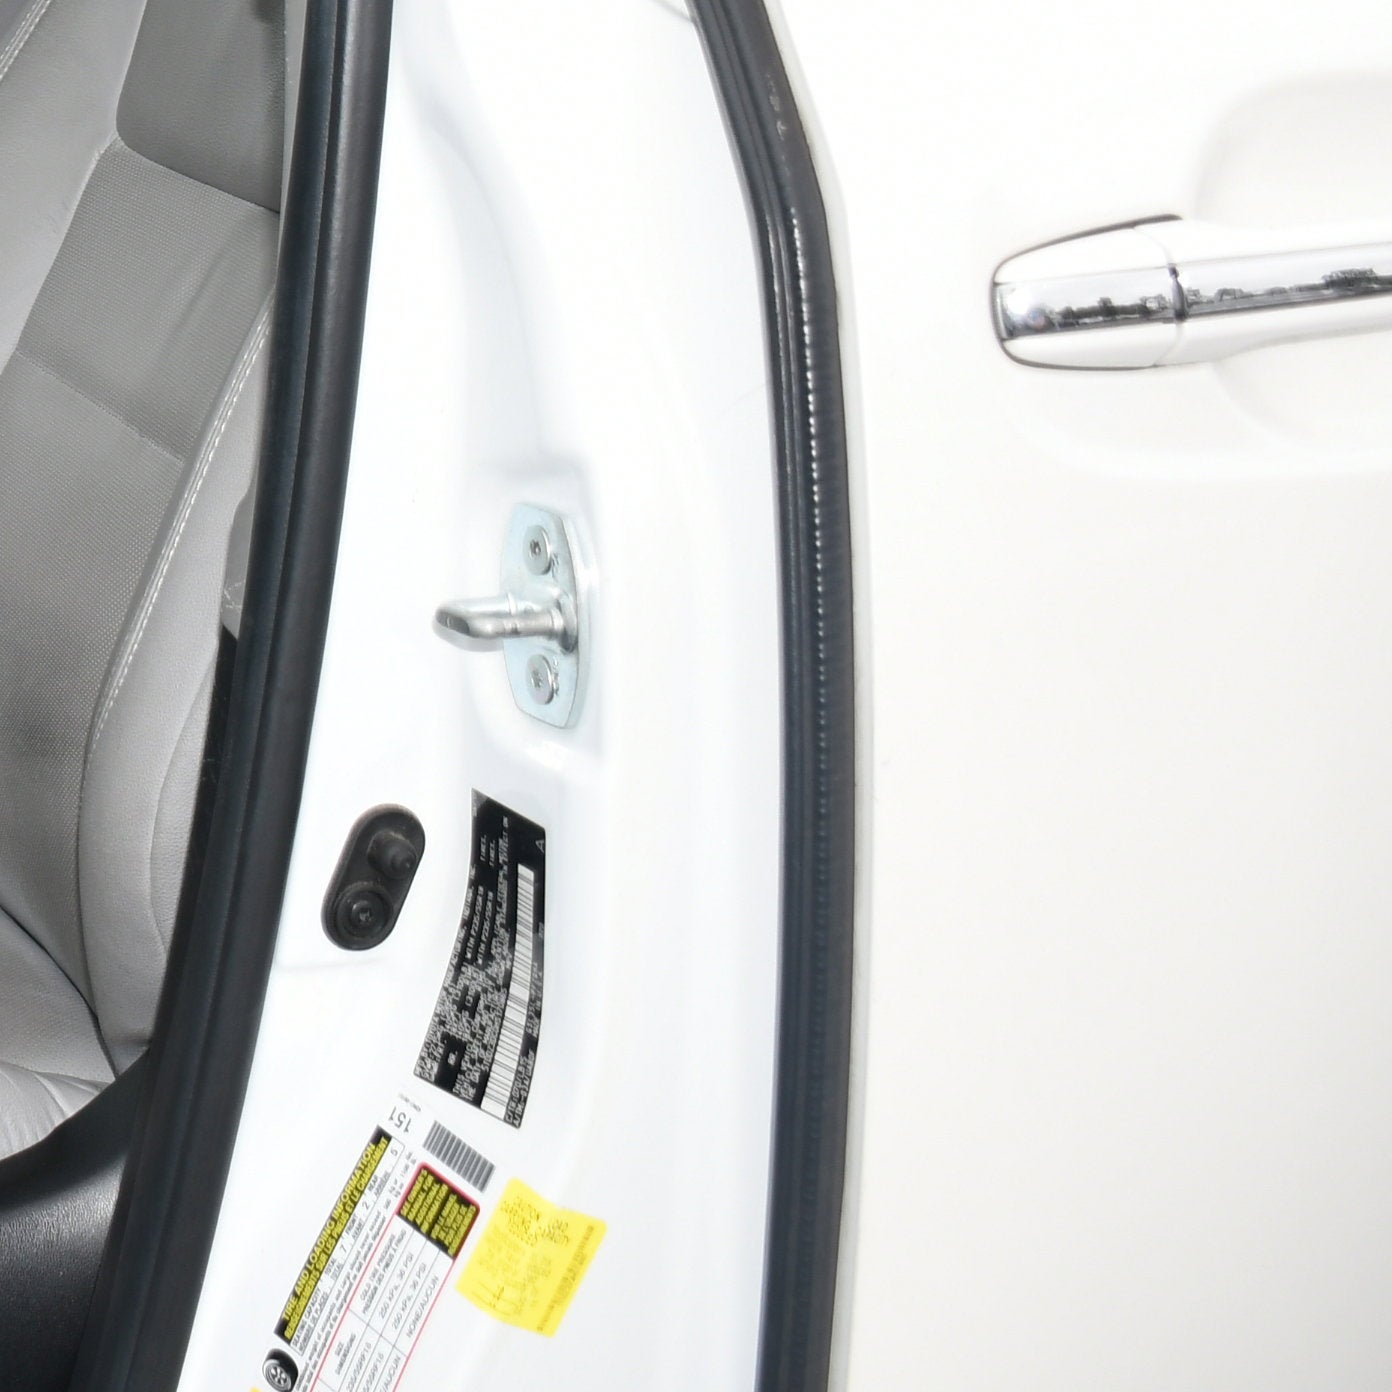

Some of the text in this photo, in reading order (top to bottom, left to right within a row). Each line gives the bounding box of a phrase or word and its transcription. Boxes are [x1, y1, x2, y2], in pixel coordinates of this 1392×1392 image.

[388, 1105, 413, 1134] 151
[316, 1252, 327, 1270] SUR
[324, 1237, 335, 1253] LES
[332, 1211, 348, 1238] PNEUS
[345, 1200, 353, 1211] ET
[351, 1188, 360, 1201] LE
[356, 1136, 387, 1191] CHARGEMENT
[340, 1244, 347, 1253] 7
[361, 1200, 369, 1209] 2
[390, 1147, 397, 1156] 5
[407, 1174, 433, 1220] MANUAL FOR
[415, 1181, 439, 1224] ADDITIONAL
[420, 1183, 448, 1233] INFORMATION
[282, 1141, 374, 1321] TIRE AND LOADING INFORMATION
[404, 1274, 439, 1338] NONE/AUCUN
